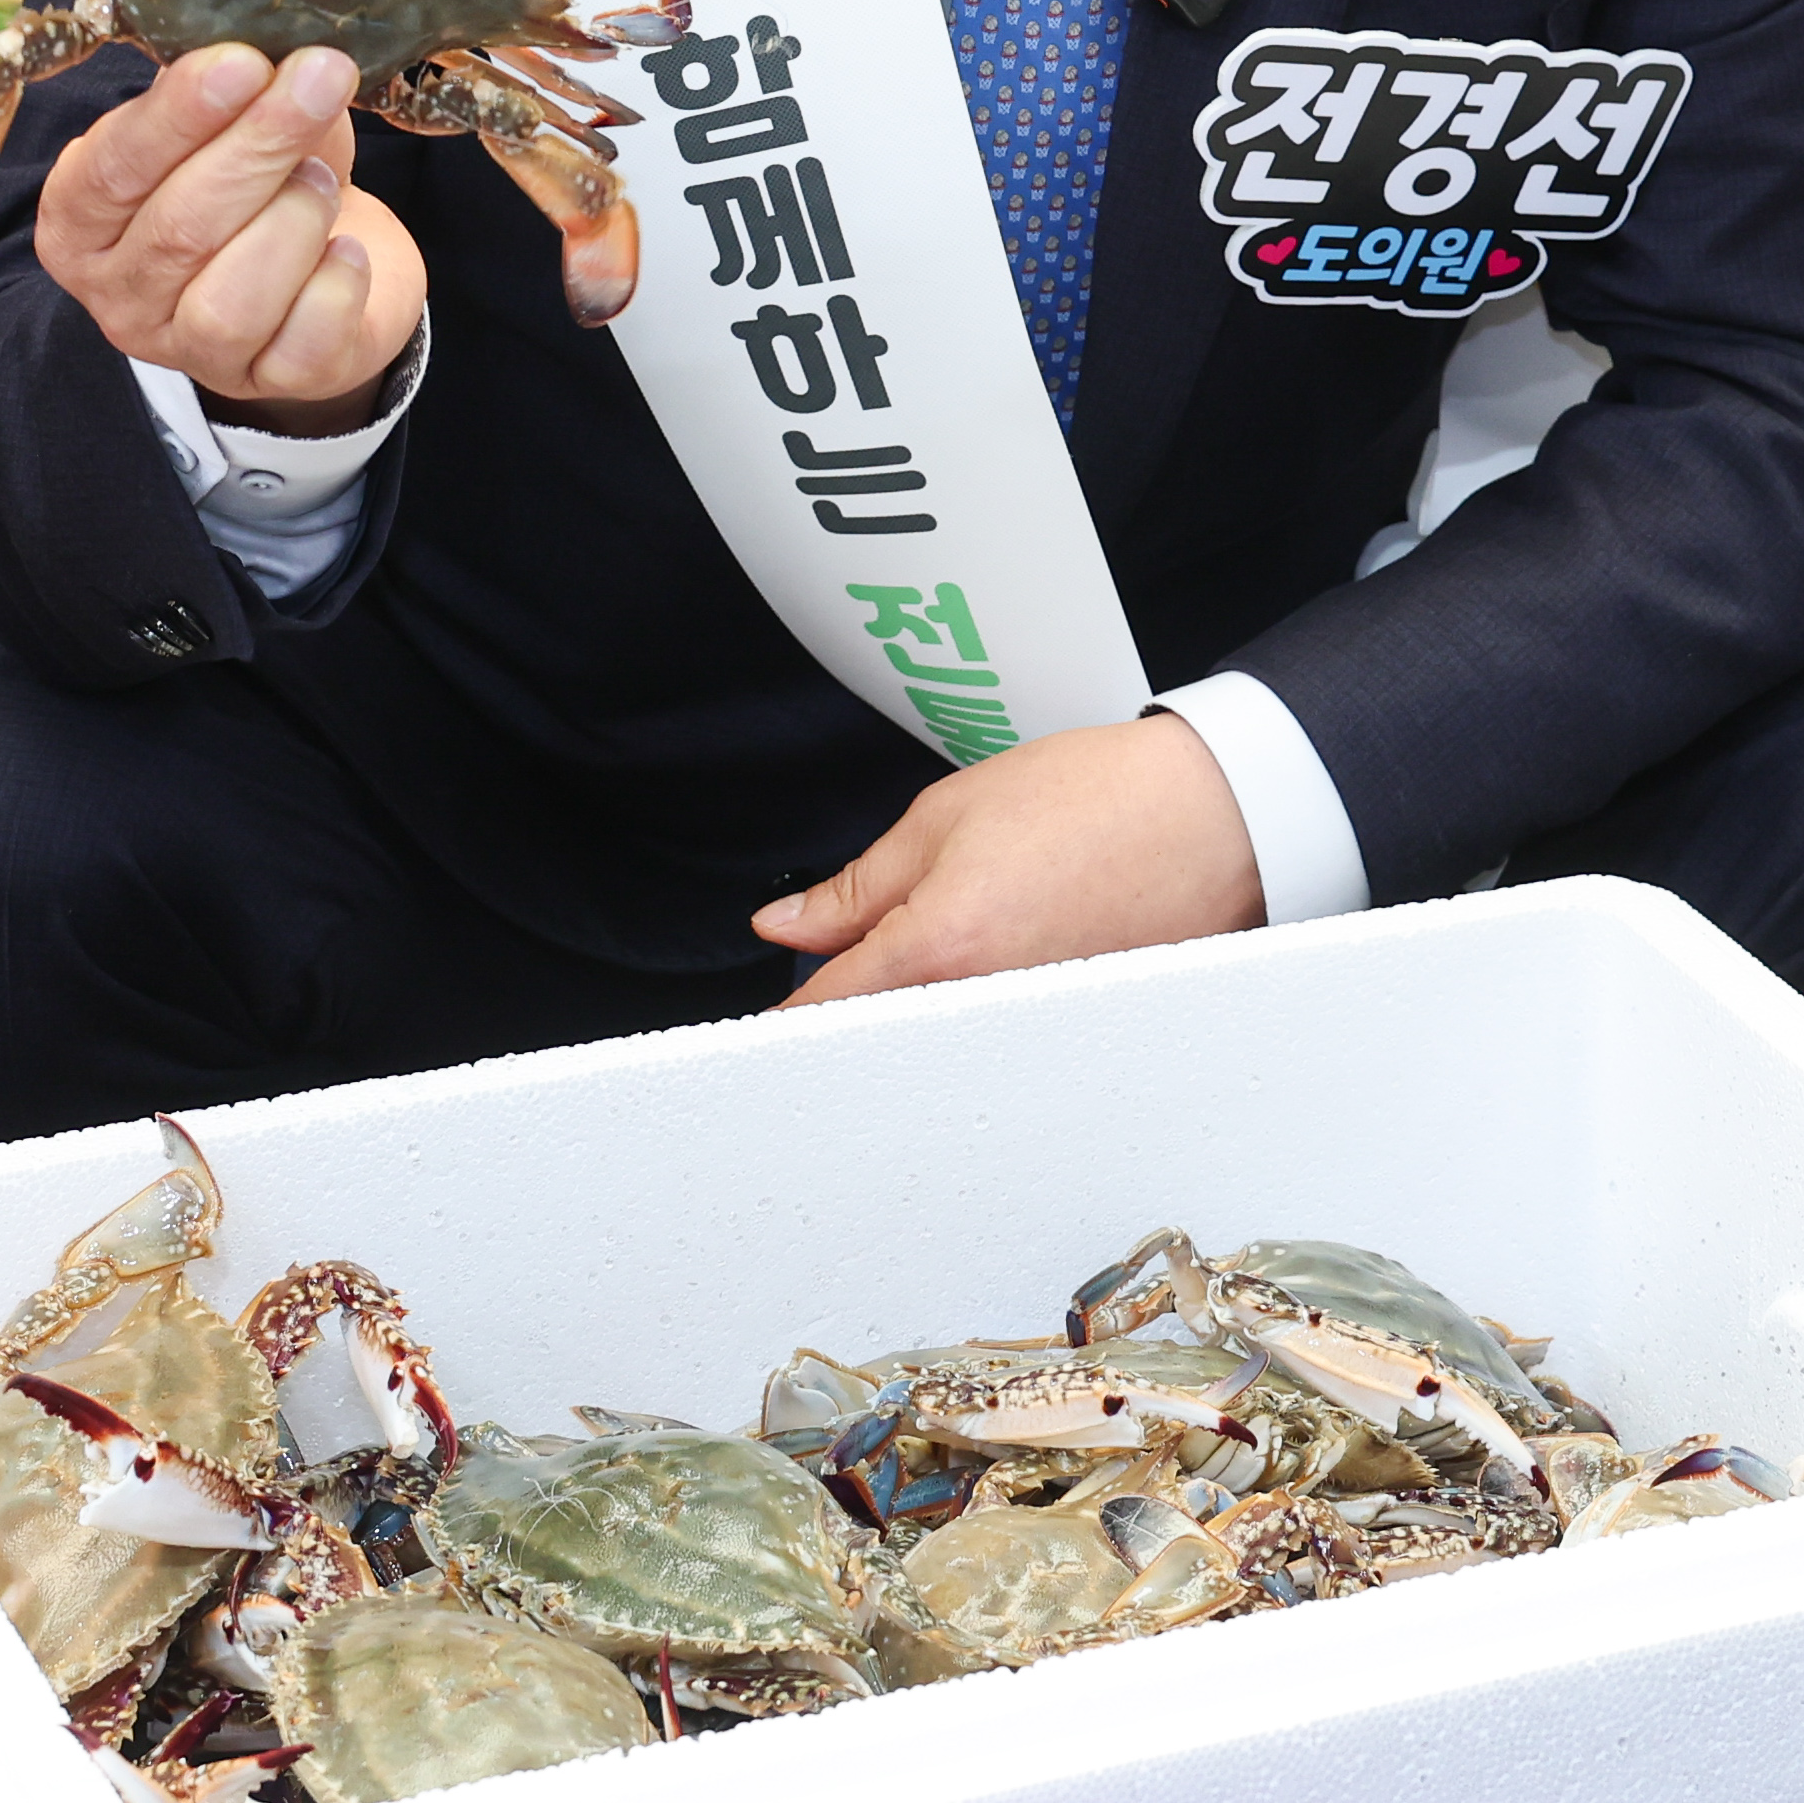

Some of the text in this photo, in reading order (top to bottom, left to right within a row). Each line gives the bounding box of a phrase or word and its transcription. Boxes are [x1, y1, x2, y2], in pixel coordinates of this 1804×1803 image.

[1224, 60, 1668, 217] 전경선
[640, 14, 938, 535] 함께하는
[1281, 223, 1495, 296] 도의원
